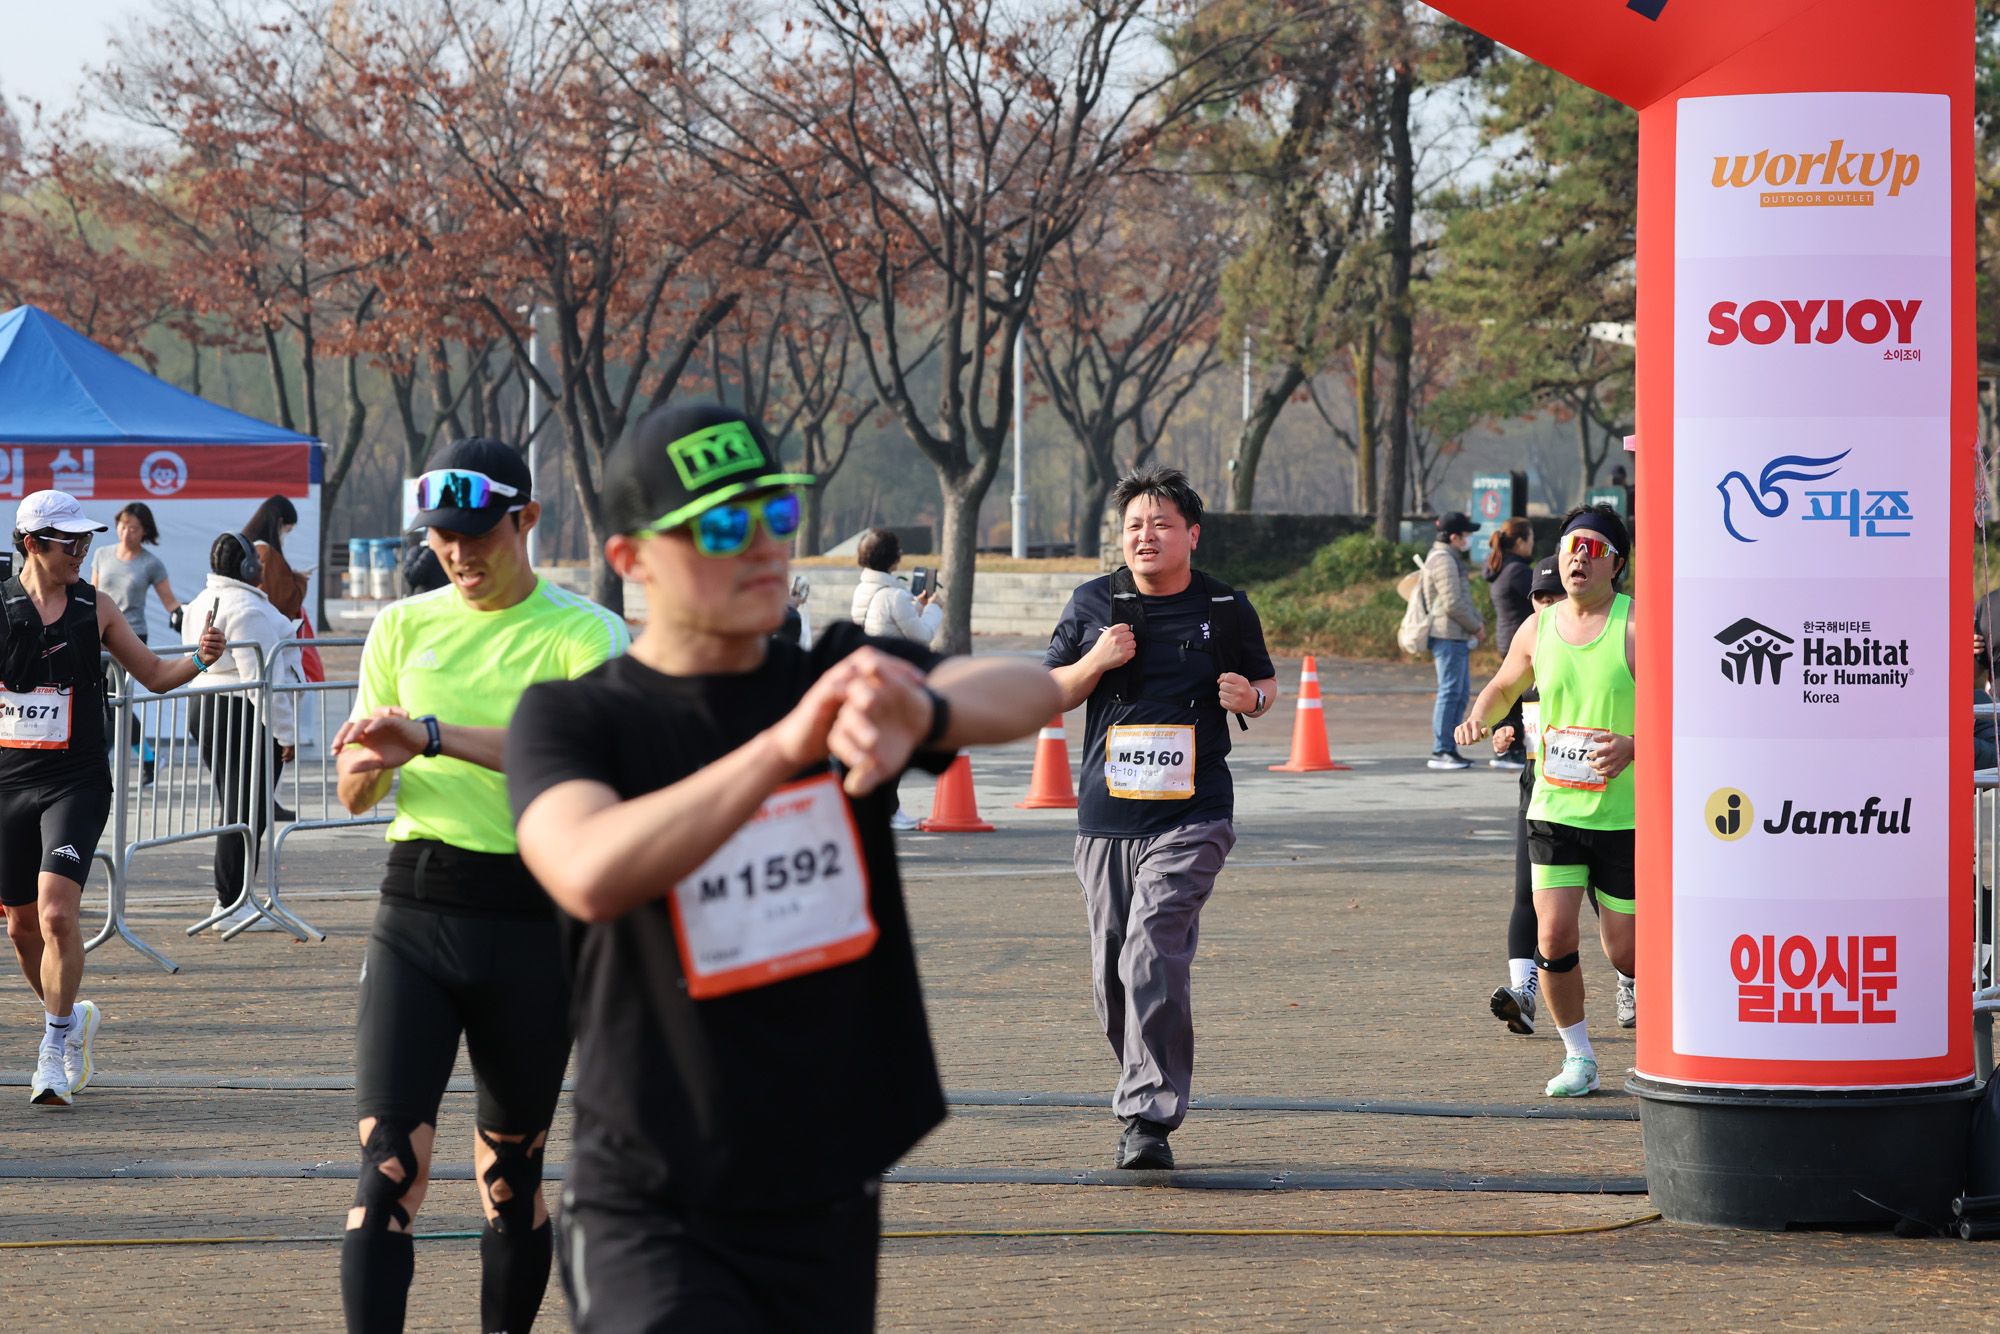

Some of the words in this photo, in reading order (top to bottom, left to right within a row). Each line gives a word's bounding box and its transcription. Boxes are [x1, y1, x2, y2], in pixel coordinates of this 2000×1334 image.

[1762, 194, 1822, 204] OUTDOOR
[1828, 194, 1872, 203] OUTLET
[1707, 299, 1923, 346] SOYJOY
[1883, 349, 1921, 362] 소이조이
[1801, 488, 1914, 537] 피죤
[1803, 621, 1872, 634] 한국해비타트
[1803, 637, 1909, 667] Habitat
[1803, 669, 1828, 685] for
[1803, 690, 1840, 703] Korea
[1119, 750, 1184, 766] M5160
[1110, 764, 1137, 777] B-101
[1763, 796, 1912, 835] Jamful
[1730, 934, 1897, 1024] 일요신문
